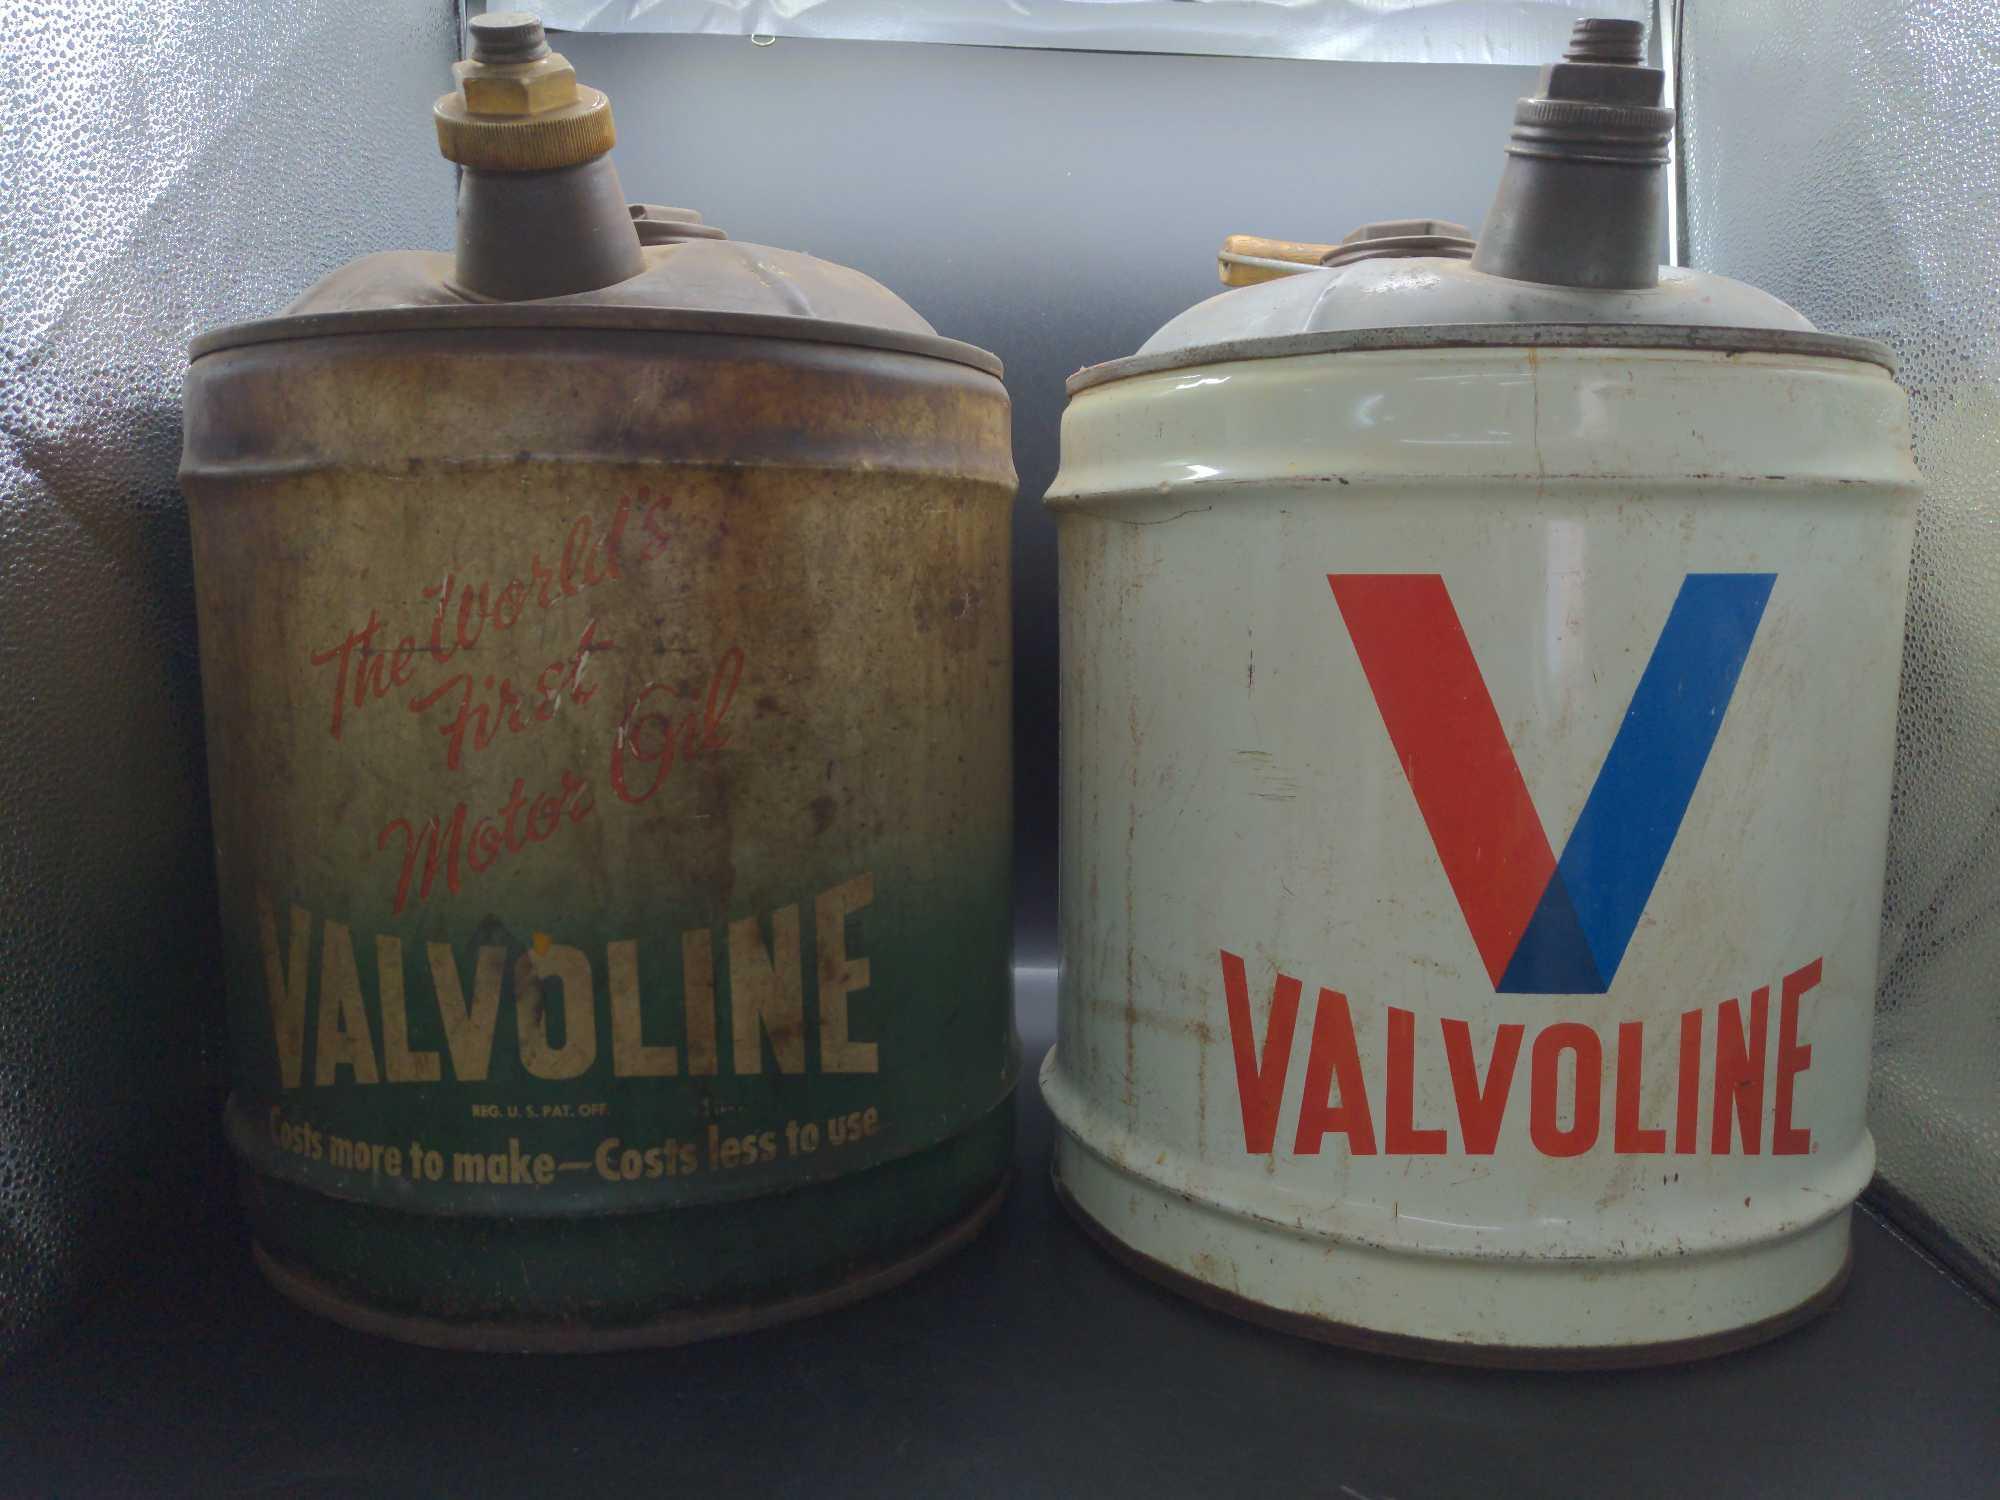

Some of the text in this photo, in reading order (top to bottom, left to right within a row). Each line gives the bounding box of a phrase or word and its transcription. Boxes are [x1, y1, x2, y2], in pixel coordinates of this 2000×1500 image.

[310, 486, 673, 742] The World's
[408, 617, 614, 771] First
[377, 645, 745, 915] Motor Oil
[1325, 572, 1779, 995] V
[257, 871, 879, 1089] VALVOLINE
[1219, 948, 1824, 1157] VALVOLINE
[270, 1105, 324, 1160] Costs
[330, 1135, 402, 1178] more
[409, 1140, 444, 1183] to
[708, 1123, 778, 1171] less
[786, 1119, 820, 1152] to
[827, 1105, 880, 1146] use
[471, 1103, 503, 1119] REG.
[543, 1103, 575, 1119] PAT.
